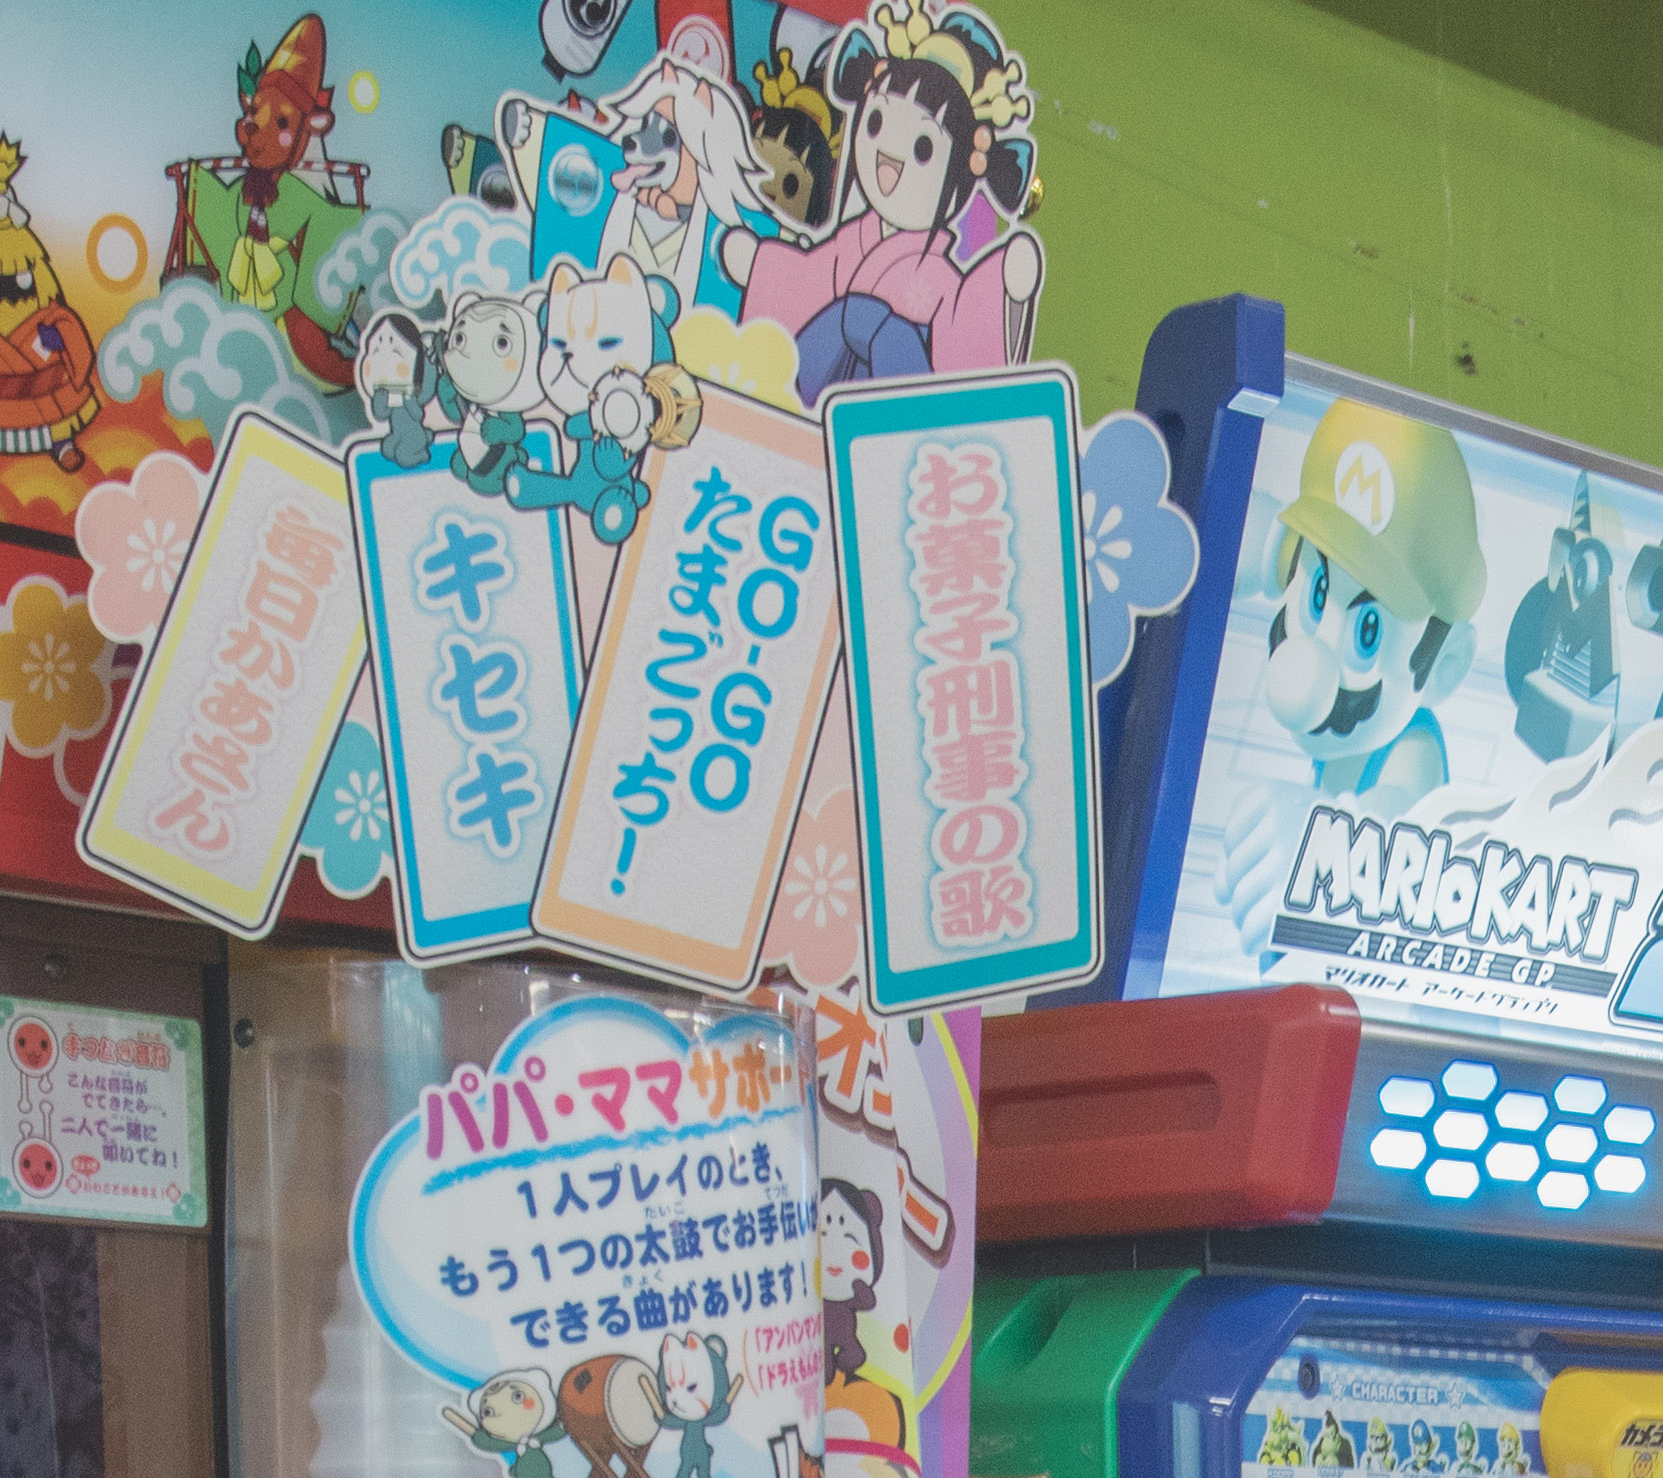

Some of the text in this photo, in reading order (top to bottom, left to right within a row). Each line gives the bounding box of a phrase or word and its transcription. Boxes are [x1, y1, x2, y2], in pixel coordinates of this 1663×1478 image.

[156, 508, 345, 855] 毎日かあさん
[416, 519, 540, 857] キセキ
[913, 447, 1035, 944] お菓子刑事の歌
[1347, 932, 1558, 990] ARCADE GP
[423, 1046, 817, 1161] パパ・ママサポー
[1351, 1380, 1438, 1406] CHARACTER
